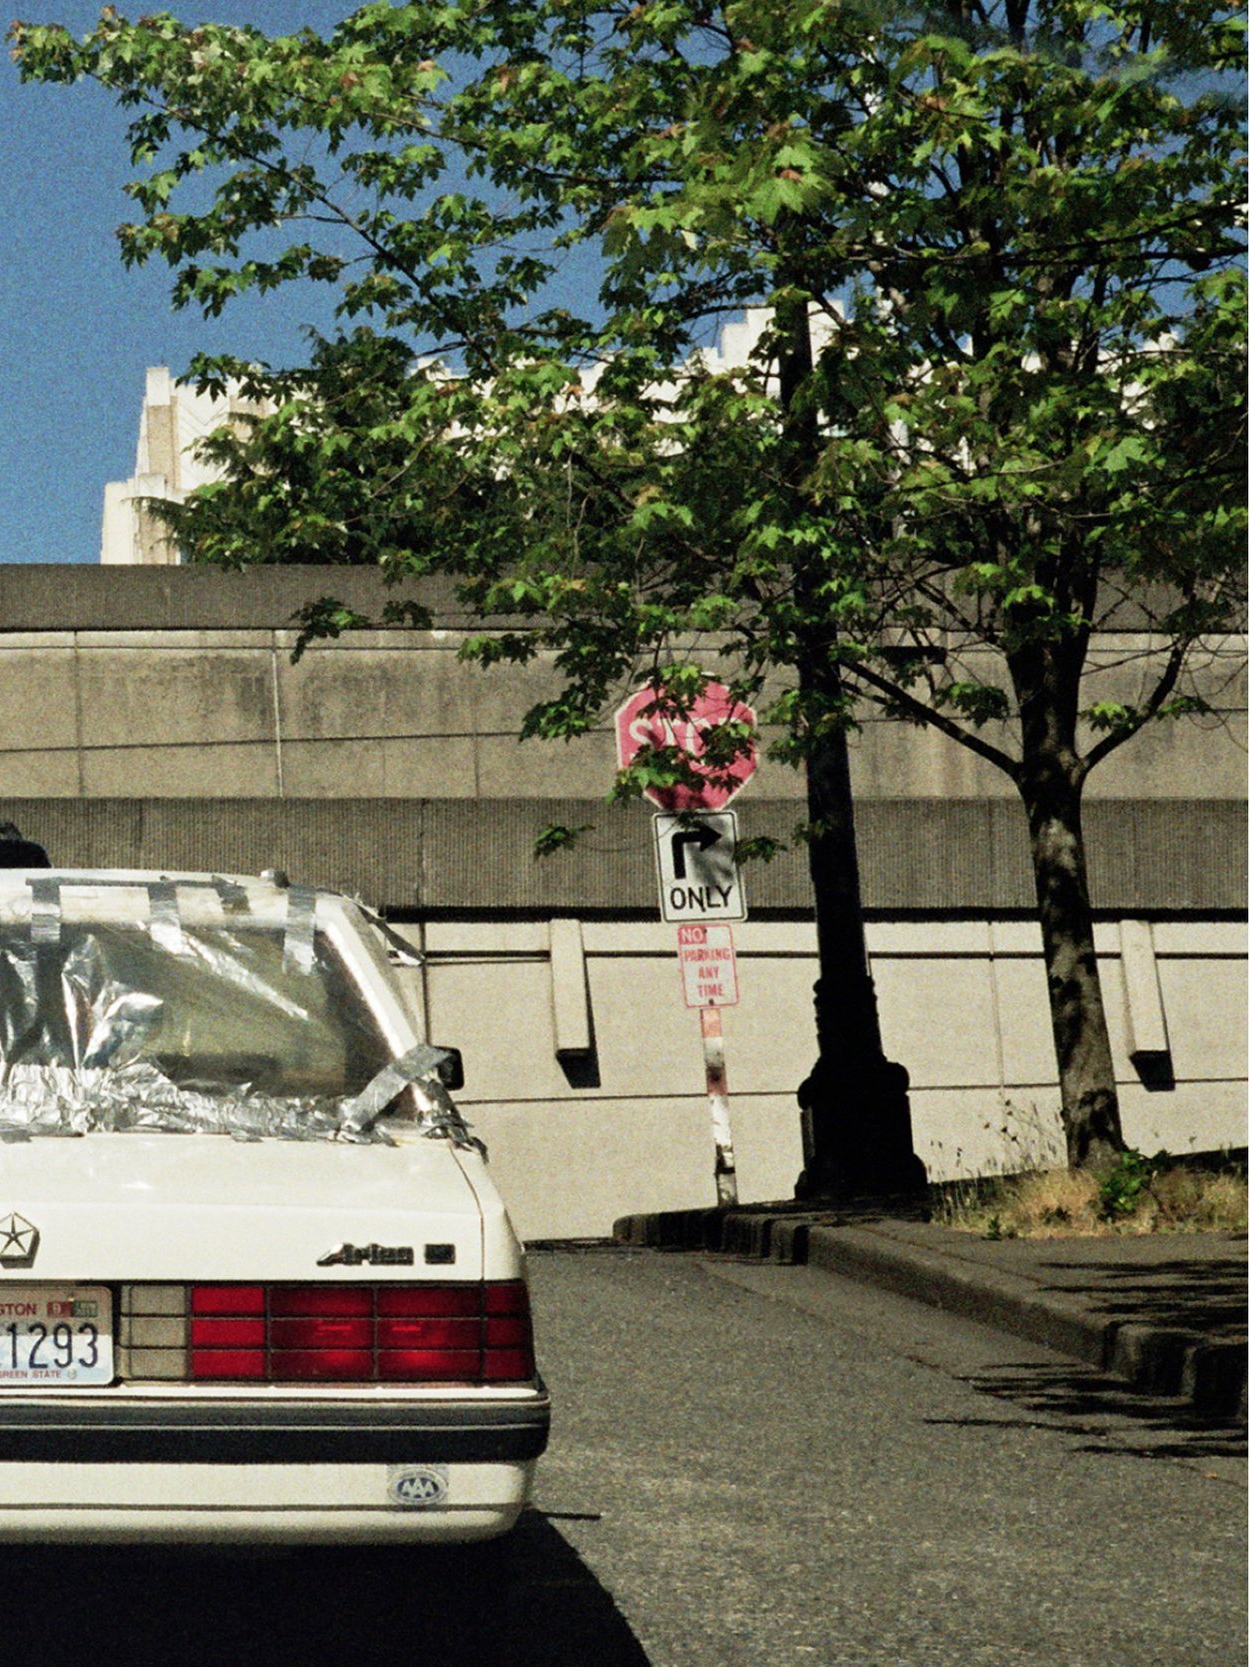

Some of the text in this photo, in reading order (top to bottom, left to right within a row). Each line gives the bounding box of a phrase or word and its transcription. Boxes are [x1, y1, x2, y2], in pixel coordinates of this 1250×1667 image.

[628, 716, 748, 766] STO
[670, 885, 733, 912] ONLY
[681, 928, 705, 943] NO
[684, 948, 731, 962] PARKING
[698, 966, 719, 979] ANY
[697, 984, 724, 997] TIME
[32, 1370, 62, 1379] STATE
[400, 1478, 437, 1498] AAA
